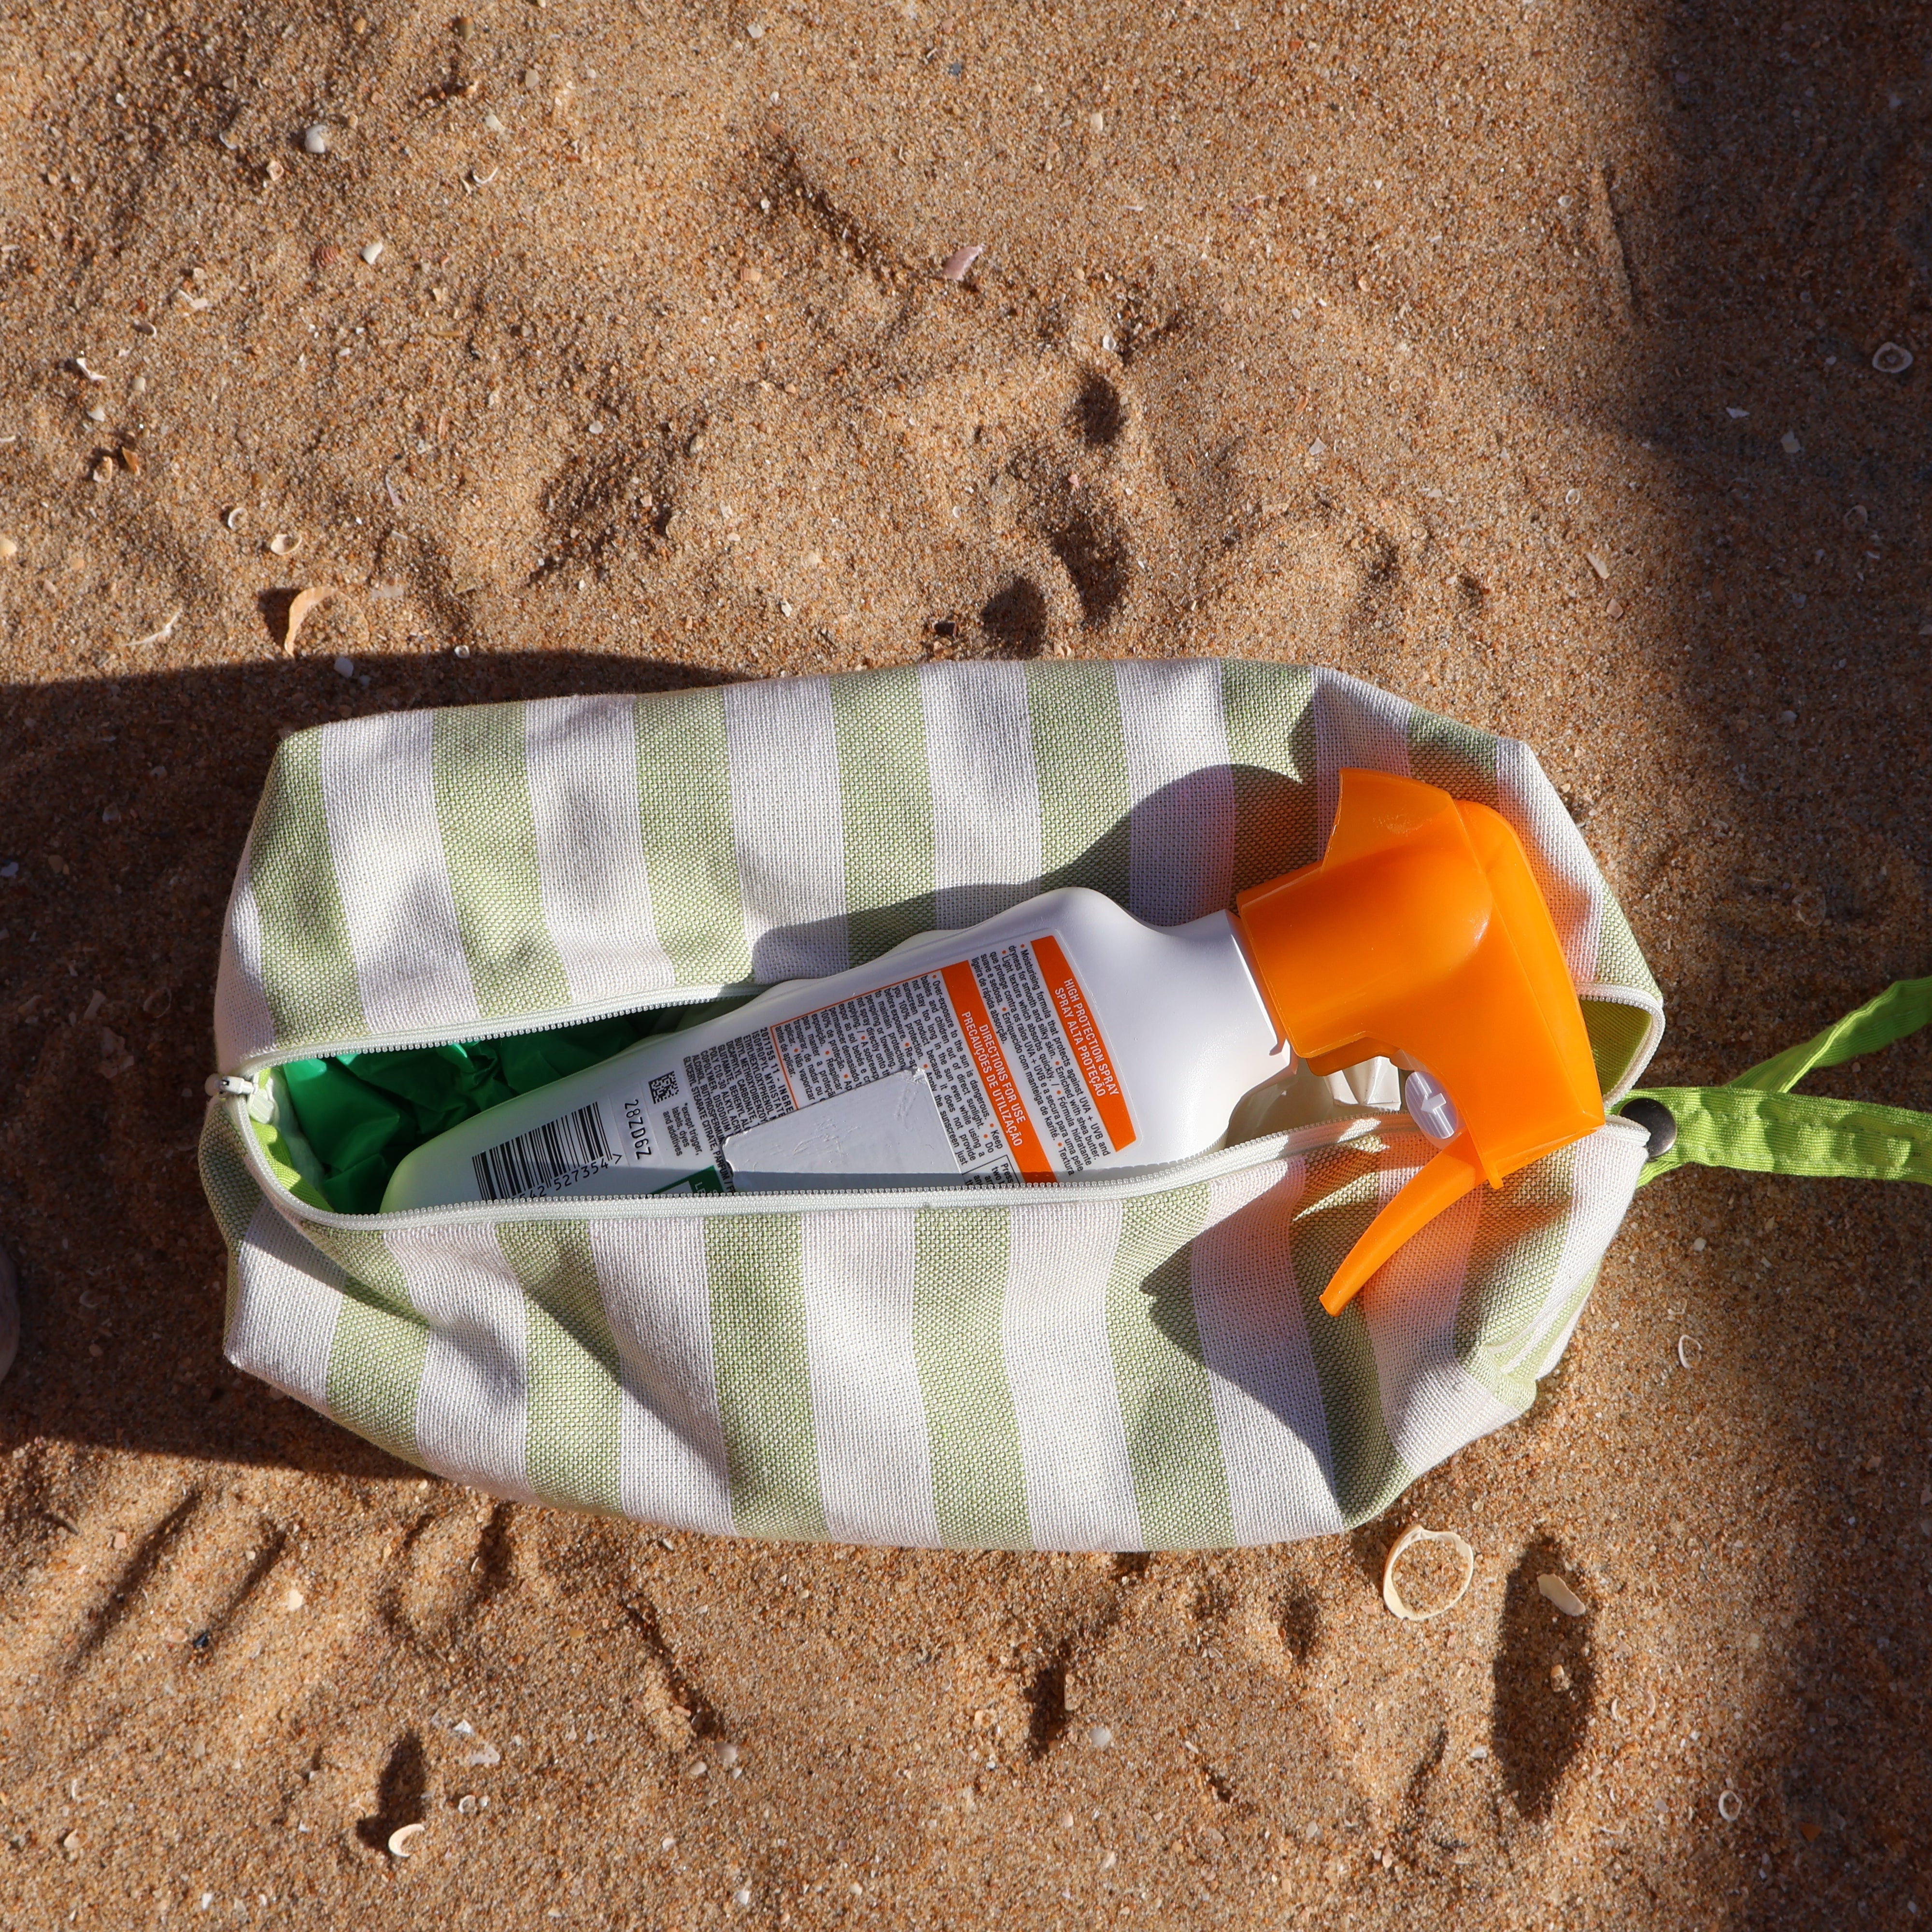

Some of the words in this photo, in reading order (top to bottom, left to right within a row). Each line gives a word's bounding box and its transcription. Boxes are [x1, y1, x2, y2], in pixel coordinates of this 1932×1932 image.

[989, 951, 999, 964] que
[1008, 945, 1022, 971] dryness
[1020, 949, 1040, 991] Moisturising
[992, 964, 1008, 990] protege
[1018, 970, 1026, 981] for
[856, 996, 866, 1009] not
[891, 985, 902, 998] you
[932, 980, 954, 1028] Over-exposure
[970, 956, 983, 978] ligeira
[981, 987, 995, 1010] rápida
[990, 1009, 1008, 1044] absorção.
[1004, 990, 1017, 1013] contra
[1022, 981, 1037, 1008] smooth
[838, 1003, 849, 1021] expor
[847, 1000, 861, 1030] applying.
[859, 1008, 871, 1026] spray
[883, 987, 895, 1009] before
[890, 1009, 906, 1041] exposure.
[898, 999, 911, 1020] 100%
[1032, 1008, 1044, 1023] and
[1036, 991, 1051, 1019] formula
[800, 1015, 811, 1031] para
[807, 1033, 820, 1056] manter
[820, 1009, 832, 1028] 100%
[829, 1039, 844, 1072] proteção.
[847, 1032, 858, 1044] sol
[864, 994, 881, 1027] perspiring
[879, 1035, 896, 1069] towelling.
[866, 1026, 880, 1052] directly
[877, 1000, 892, 1029] maintain
[888, 1032, 907, 1071] protection,
[950, 1029, 958, 1038] to
[1016, 1023, 1028, 1041] raios
[1037, 1023, 1049, 1040] silky
[1047, 1019, 1059, 1036] that
[1064, 978, 1080, 1002] HIGH
[1073, 1002, 1104, 1063] PROTECTION
[1098, 1063, 1119, 1094] SPRAY
[734, 1036, 745, 1058] BUTYL
[751, 1030, 769, 1072] ISOPROPYL
[759, 1026, 776, 1061] 2071755
[770, 1063, 780, 1074] 11
[775, 1025, 785, 1044] antes
[782, 1052, 796, 1078] aplicar.
[793, 1018, 808, 1052] transpirar,
[807, 1064, 819, 1084] nadar
[811, 1013, 826, 1047] exposição.
[825, 1057, 842, 1090] Reaplicar
[825, 1006, 847, 1044] permanecer
[841, 1044, 860, 1082] demasiado
[904, 1022, 923, 1060] protection.
[920, 975, 932, 997] babies
[928, 999, 940, 1013] and
[934, 1016, 950, 1044] children
[946, 1047, 957, 1060] out
[956, 1073, 971, 1095] direct
[966, 1097, 984, 1129] sunlight.
[953, 1039, 963, 1052] the
[1023, 1040, 1036, 1058] UVA
[1044, 1040, 1056, 1059] skin.
[1051, 1036, 1070, 1067] protects
[1054, 988, 1074, 1018] SPRAY
[1067, 1021, 1083, 1045] ALTA
[1078, 1045, 1106, 1096] PROTEÇÃO
[708, 1046, 720, 1063] POLY
[783, 1023, 796, 1047] aplicar.
[793, 1052, 803, 1068] Não
[798, 1068, 815, 1100] vaporizar
[852, 1044, 865, 1066] bebés
[875, 1052, 886, 1069] onto
[911, 979, 921, 991] not
[916, 992, 926, 1007] stay
[922, 1009, 931, 1022] too
[927, 1023, 938, 1040] long
[938, 1052, 947, 1065] the
[943, 1067, 954, 1082] sun
[950, 1084, 962, 1103] even
[959, 1105, 971, 1125] while
[968, 1127, 981, 1149] using
[959, 1054, 969, 1068] sun
[980, 953, 992, 973] suave
[989, 978, 1003, 1006] sedosa.
[1001, 1011, 1023, 1053] Enriquecido
[1018, 1054, 1029, 1071] com
[1025, 1071, 1044, 1106] manteiga
[1039, 1106, 1048, 1116] de
[1044, 1115, 1060, 1140] karité.
[1058, 1146, 1075, 1176] Textura
[1001, 954, 1014, 973] Light
[1008, 973, 1022, 998] texture
[1018, 999, 1032, 1022] which
[1026, 1023, 1043, 1051] absorbs
[1038, 1053, 1054, 1081] quickly.
[1057, 1096, 1074, 1127] Fórmula
[1071, 1127, 1092, 1165] hidratante
[691, 1054, 705, 1084] ALCOHOL,
[713, 1064, 726, 1089] C10-30
[717, 1044, 734, 1085] GLUTAMATE,
[728, 1084, 745, 1118] BEHENYL
[725, 1039, 742, 1079] DICAPRYLYL
[737, 1078, 757, 1123] CARBONATE,
[736, 1034, 781, 1115] ETHYLHEXYLOXYPHENOL
[902, 981, 918, 1015] sunscreen
[913, 1018, 931, 1046] product
[925, 1049, 942, 1080] because
[943, 1094, 955, 1112] does
[952, 1116, 964, 1130] not
[958, 1133, 976, 1161] provide
[962, 1011, 992, 1073] PRECAUÇÕES
[986, 1074, 998, 1088] DE
[992, 1089, 1023, 1146] UTILIZAÇÃO
[979, 1024, 1008, 1081] DIRECTIONS
[1002, 1082, 1016, 1102] FOR
[1011, 1103, 1025, 1123] USE
[1033, 1064, 1046, 1081] UVB
[1055, 1065, 1075, 1099] Enriched
[1066, 1068, 1084, 1096] against
[700, 1050, 718, 1094] COPOLYMER,
[712, 1094, 732, 1132] DISODIUM
[721, 1091, 734, 1114] ALKYL
[934, 1094, 943, 1108] the
[969, 1079, 990, 1120] dangerous.
[662, 1110, 673, 1125] and
[682, 1055, 696, 1087] GLYCERYL
[691, 1086, 708, 1120] STEARATE
[701, 1119, 718, 1151] CITRATE,
[713, 1150, 729, 1180] PARFUM
[1045, 1094, 1061, 1120] secura
[1069, 1098, 1081, 1116] with
[1079, 1096, 1092, 1114] UVA
[624, 1098, 652, 1160] 28ZD6Z
[671, 1106, 683, 1130] labels,
[679, 1130, 690, 1148] dyes
[939, 1110, 960, 1148] sunscreen
[1054, 1120, 1068, 1138] para
[1076, 1116, 1089, 1135] shea
[1090, 1122, 1103, 1140] UVB
[667, 1124, 682, 1156] additives
[688, 1128, 702, 1155] trigger,
[990, 1129, 1003, 1149] Keep
[1064, 1137, 1076, 1155] uma
[1084, 1135, 1099, 1160] butter.
[1098, 1141, 1111, 1156] and
[954, 1150, 968, 1165] just
[1070, 1155, 1083, 1172] pele
[991, 1166, 1002, 1181] two
[1000, 1162, 1014, 1184] Press
